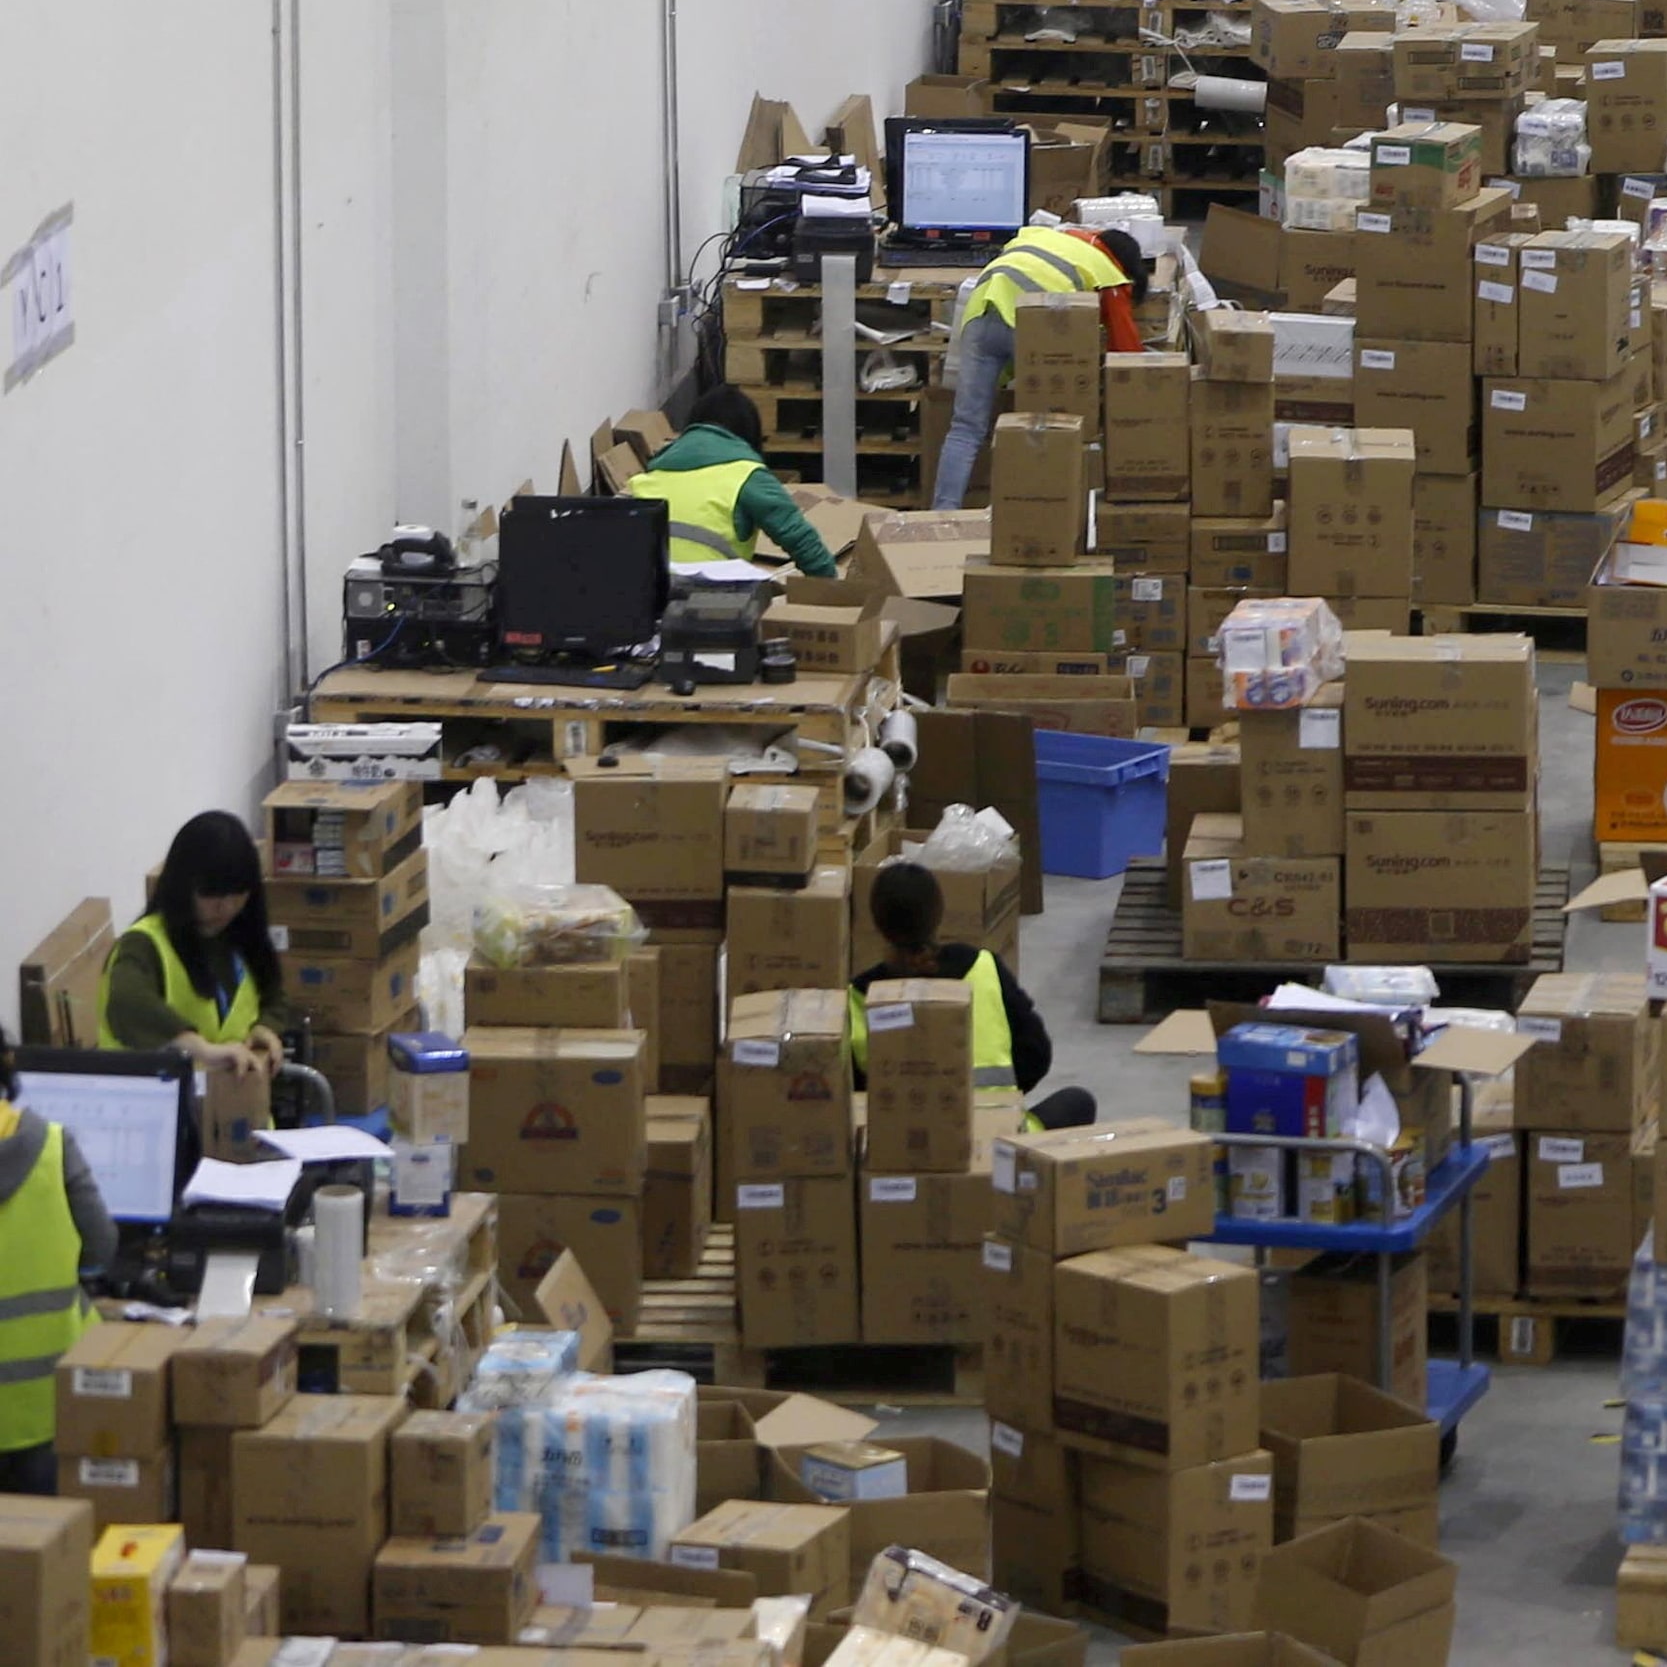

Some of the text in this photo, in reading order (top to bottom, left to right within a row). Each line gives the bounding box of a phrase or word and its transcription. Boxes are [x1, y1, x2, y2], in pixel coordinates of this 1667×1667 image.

[1366, 695, 1450, 713] Suning.com
[1365, 854, 1451, 871] Suning.com
[1151, 1188, 1168, 1215] 3
